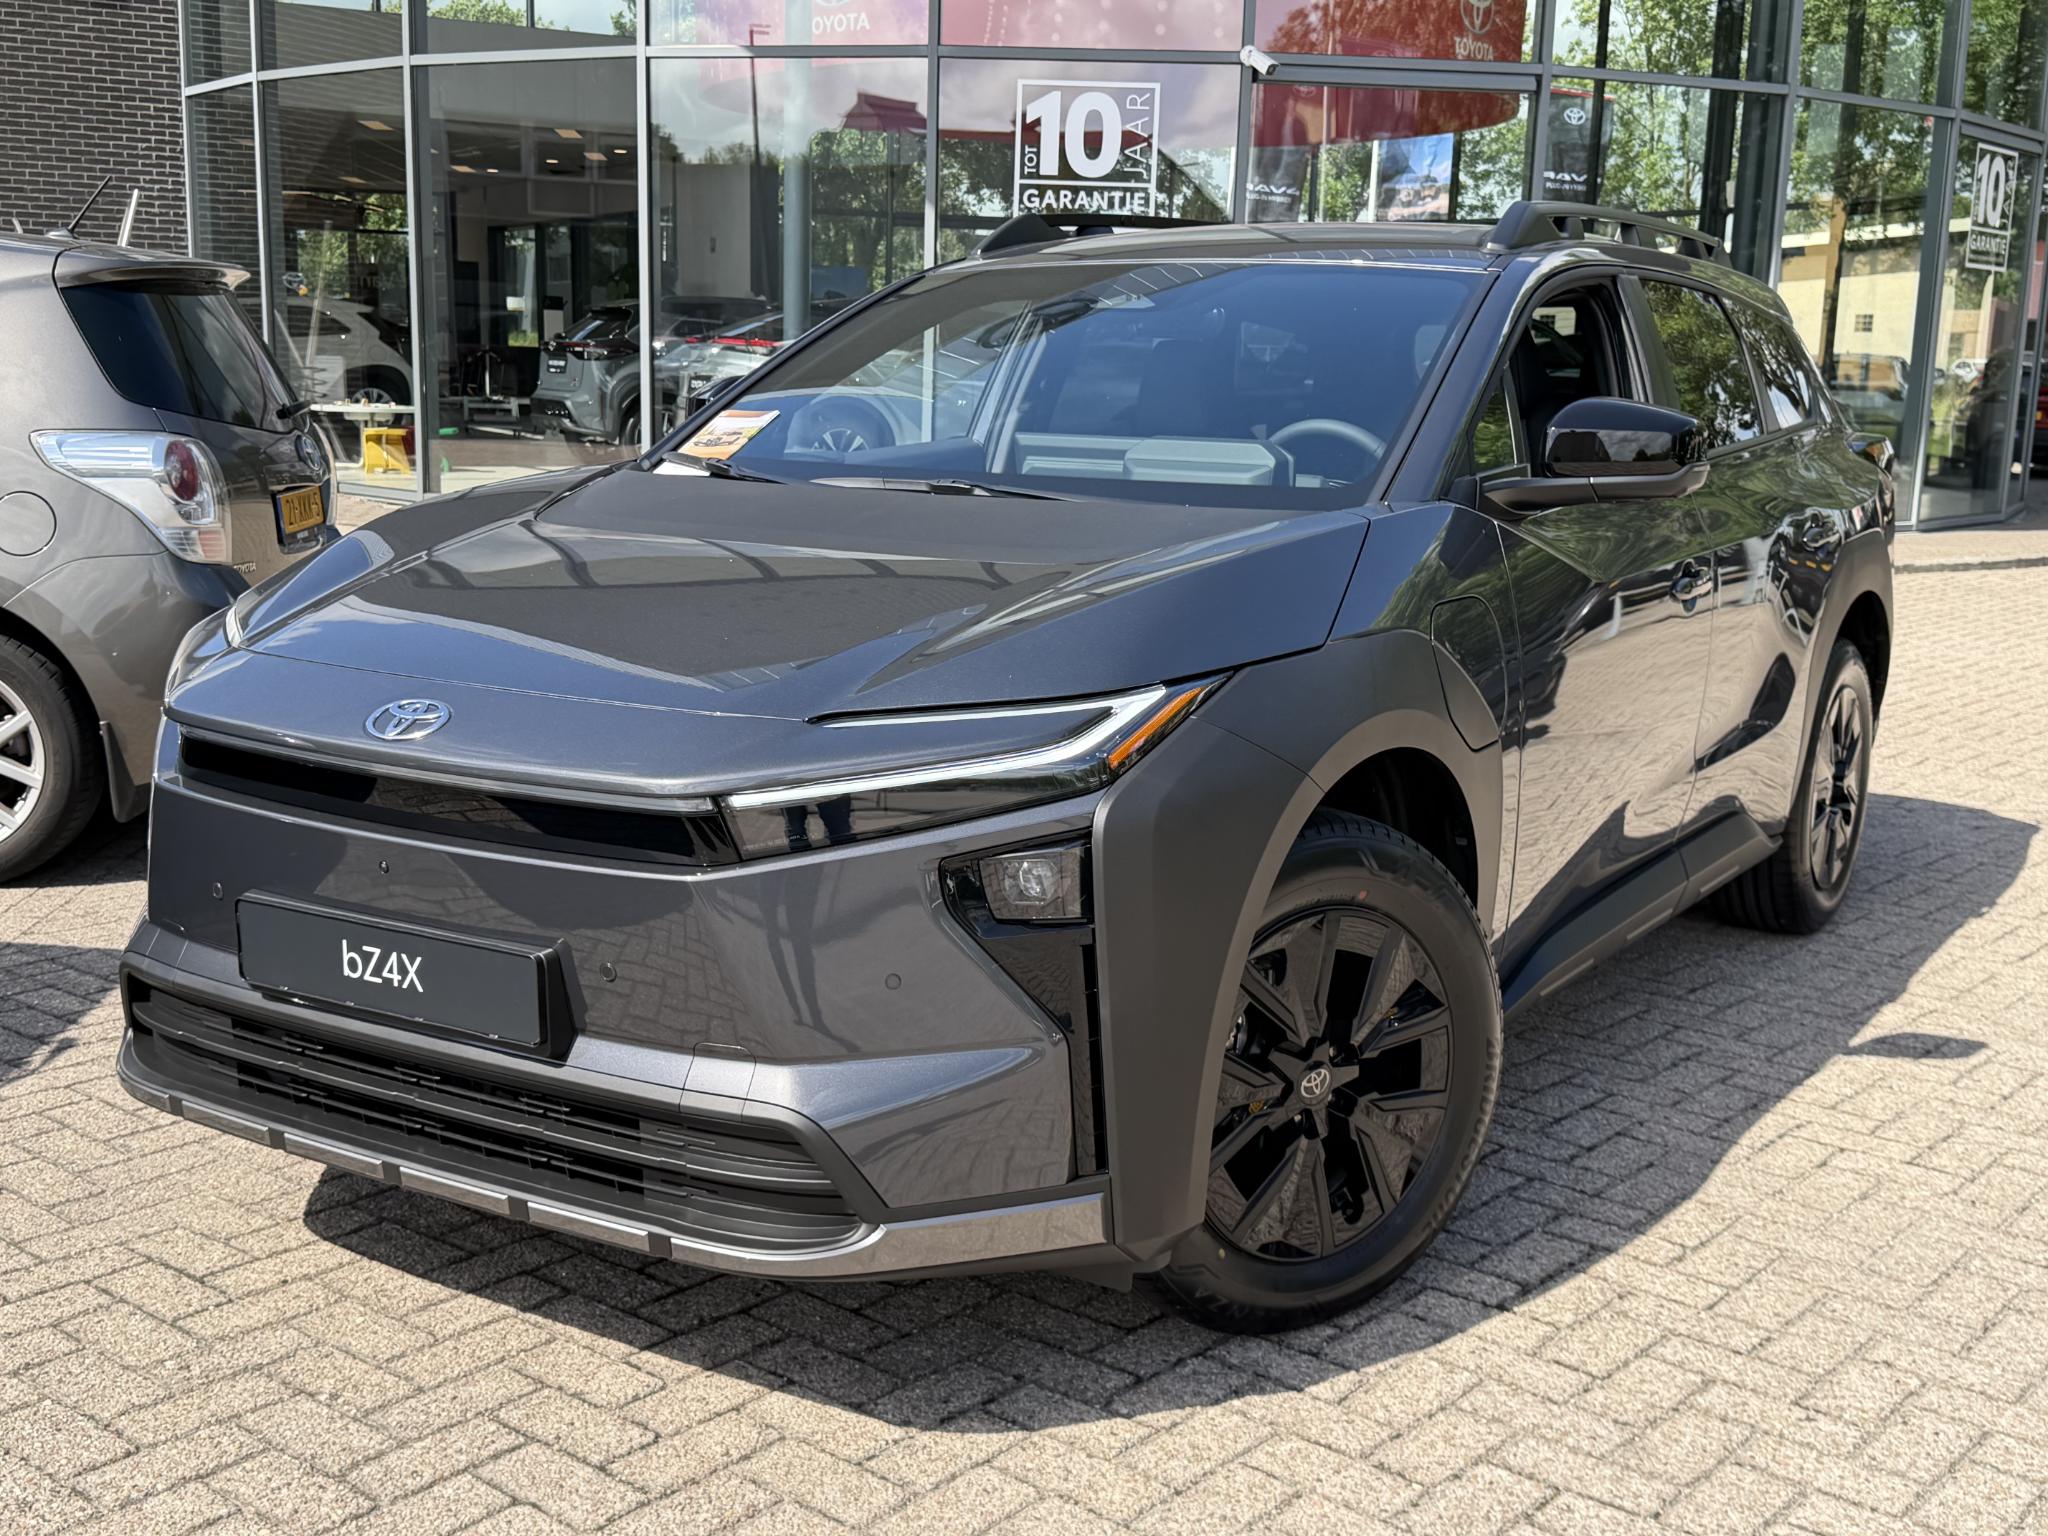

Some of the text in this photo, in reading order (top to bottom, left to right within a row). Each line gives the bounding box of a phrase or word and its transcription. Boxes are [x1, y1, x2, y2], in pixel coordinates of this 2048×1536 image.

[811, 12, 870, 34] OYOTA
[1453, 34, 1494, 61] TOYOTA
[1026, 90, 1122, 179] 10
[1123, 92, 1151, 179] JAAR
[1023, 144, 1038, 175] TOT
[1543, 170, 1602, 184] RAV
[1977, 153, 2005, 228] 10
[1022, 188, 1146, 211] GARANTIE
[1969, 233, 2007, 255] GARANTIE
[342, 939, 423, 993] bZ4X
